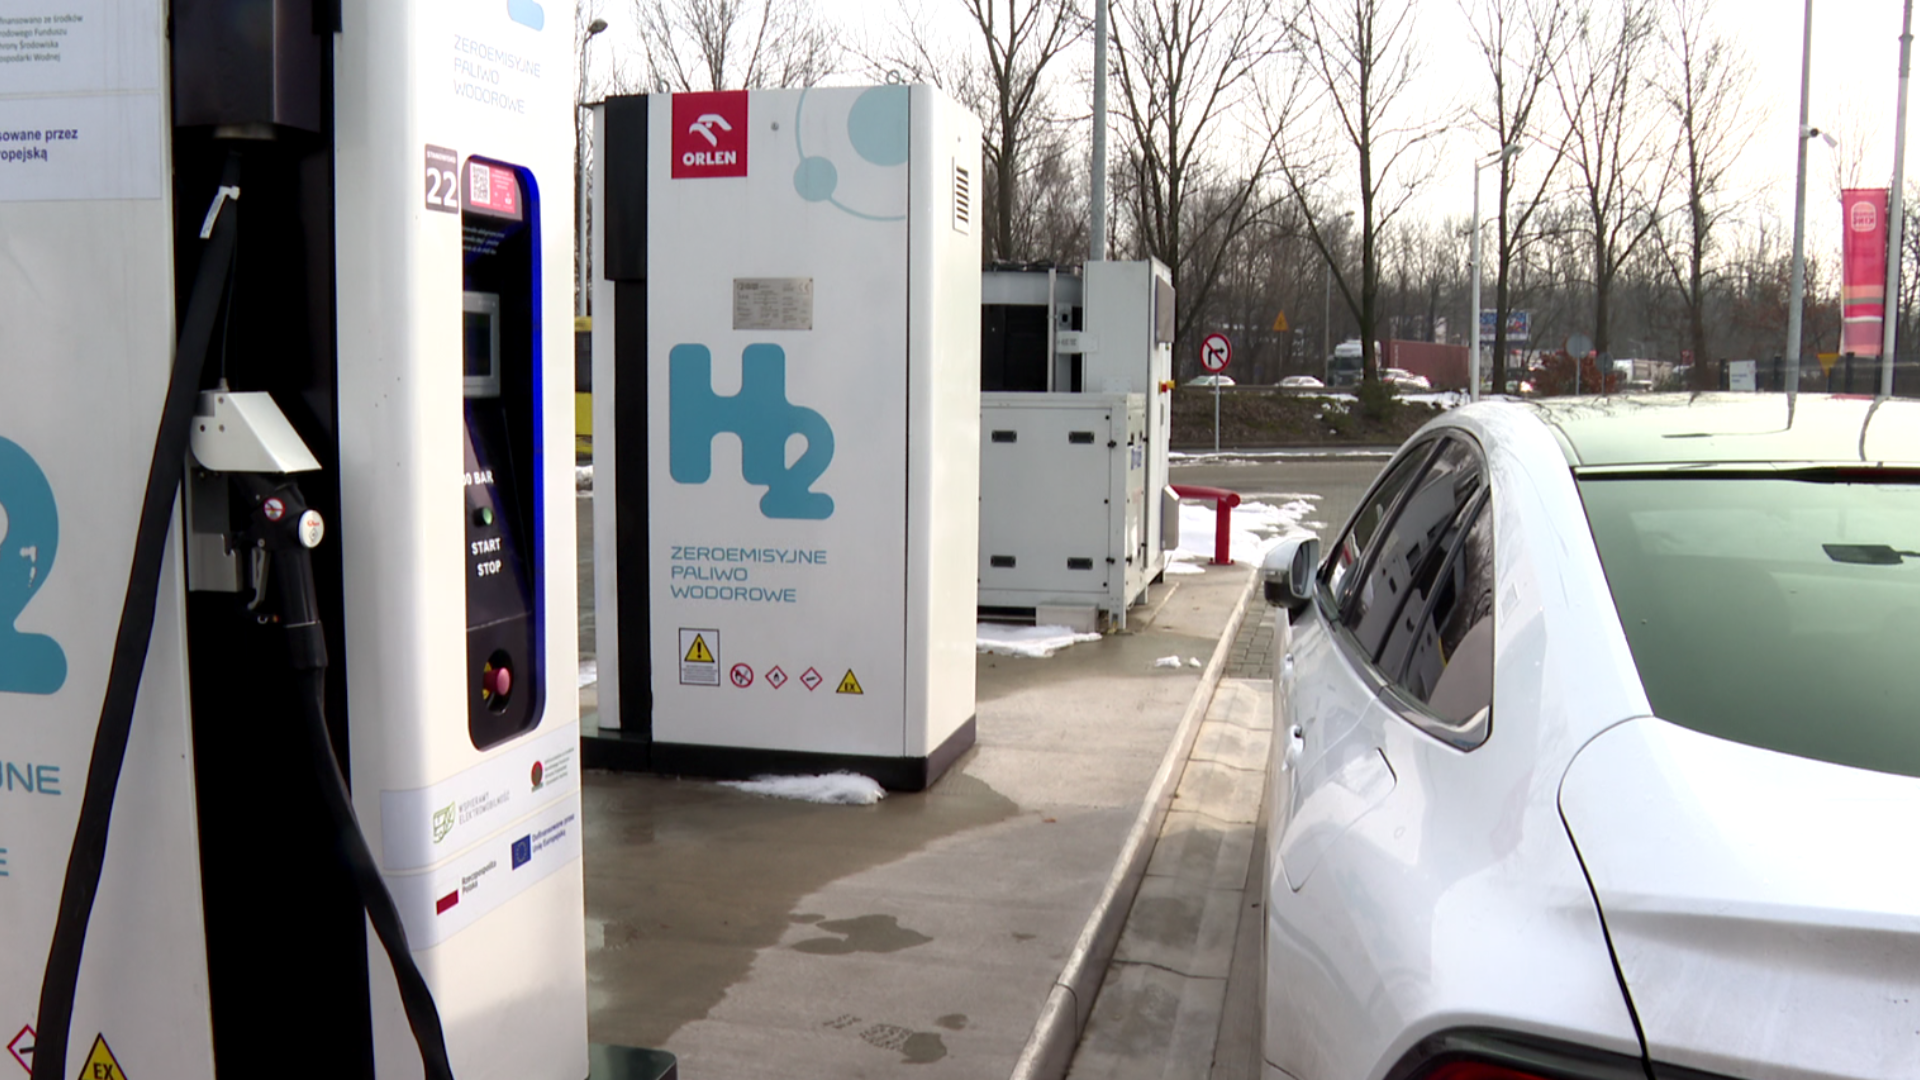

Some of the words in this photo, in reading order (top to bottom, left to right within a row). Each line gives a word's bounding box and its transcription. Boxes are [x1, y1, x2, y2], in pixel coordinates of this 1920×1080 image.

[454, 33, 541, 78] ZEROEMISYJNE
[454, 56, 500, 85] PALIWO
[453, 78, 525, 115] WODOROWE
[45, 128, 79, 143] przez
[0, 146, 48, 163] opejską
[682, 151, 737, 166] ORLEN
[426, 167, 458, 208] 22
[474, 470, 494, 485] BAR
[471, 537, 501, 556] START
[671, 546, 827, 565] ZEROEMISYJNE
[477, 560, 502, 577] STOP
[671, 566, 748, 581] PALIWO
[670, 585, 796, 603] WODOROWE
[93, 1062, 113, 1080] EX
